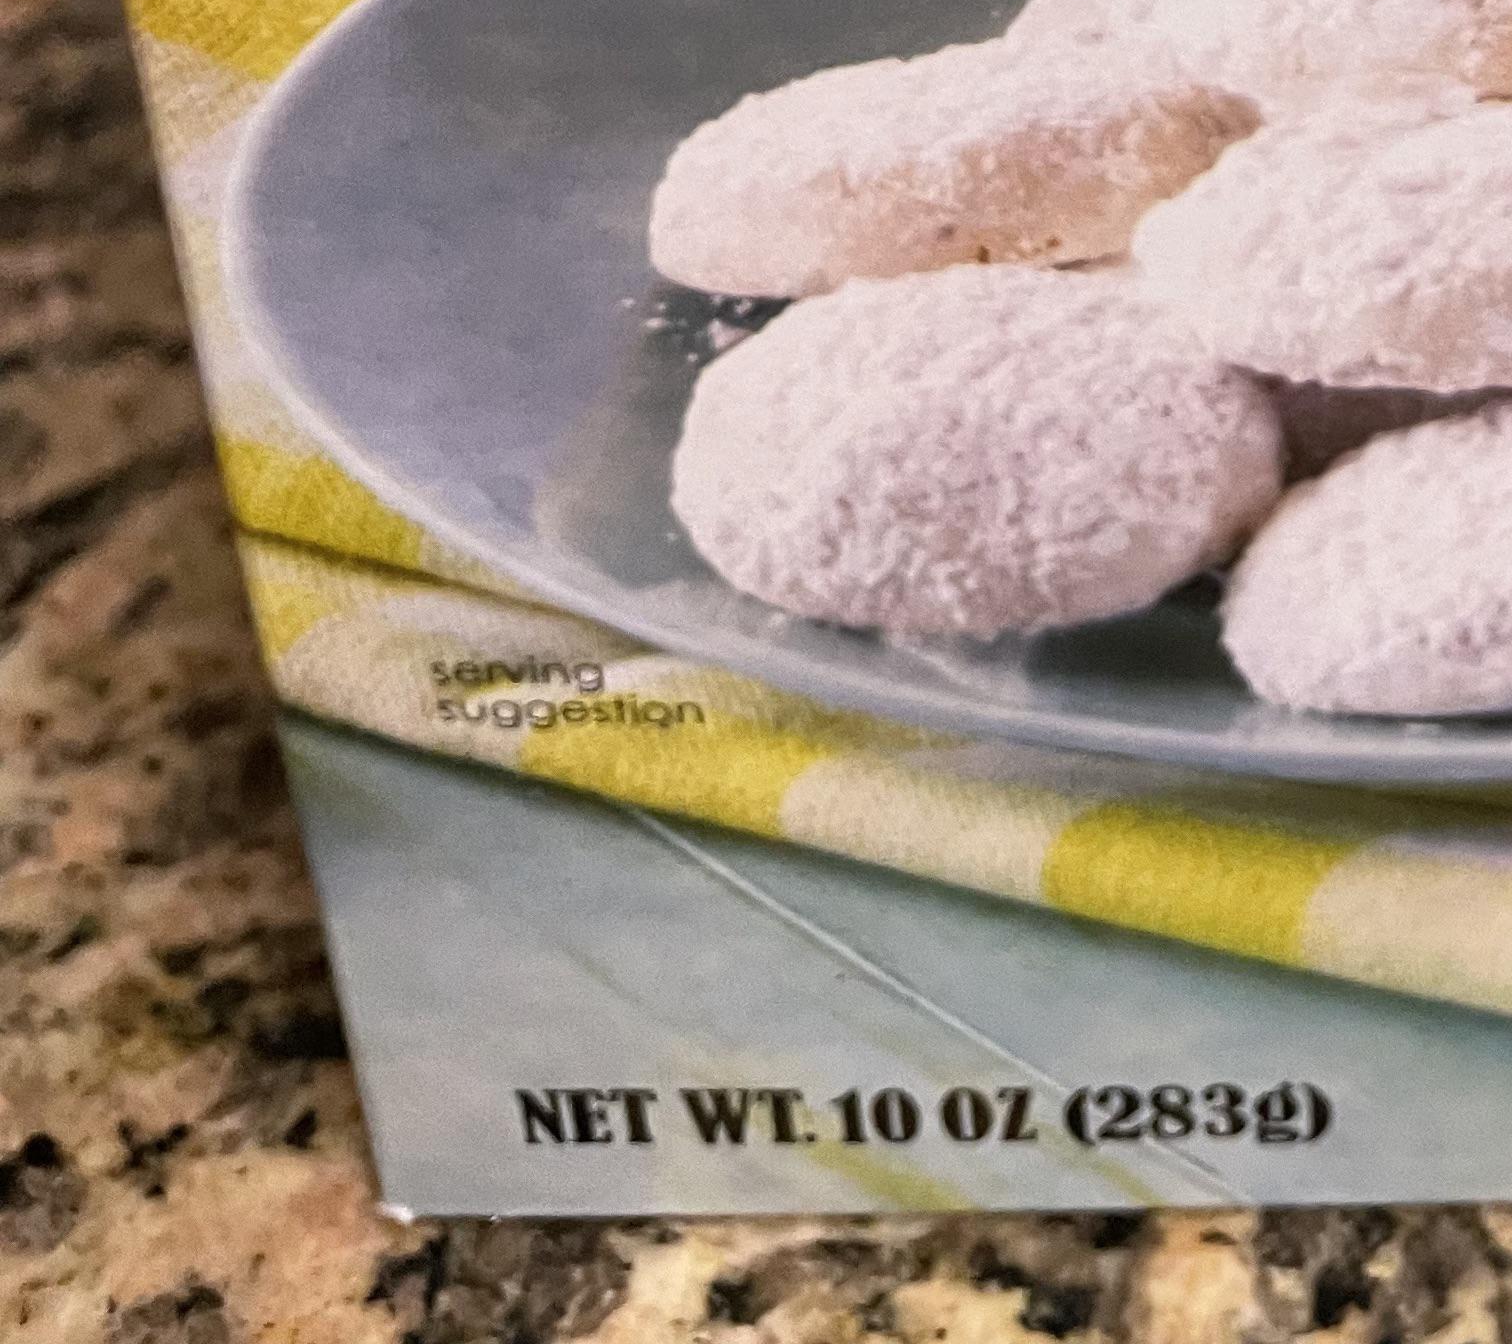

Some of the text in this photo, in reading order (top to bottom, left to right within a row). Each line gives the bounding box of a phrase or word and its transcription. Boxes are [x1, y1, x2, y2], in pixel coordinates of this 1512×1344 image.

[430, 654, 603, 692] serving
[436, 692, 705, 729] suggestion
[515, 1089, 657, 1145] NET
[833, 1089, 919, 1145] 10
[941, 1088, 1037, 1142] OZ
[1064, 1082, 1332, 1148] (283g)
